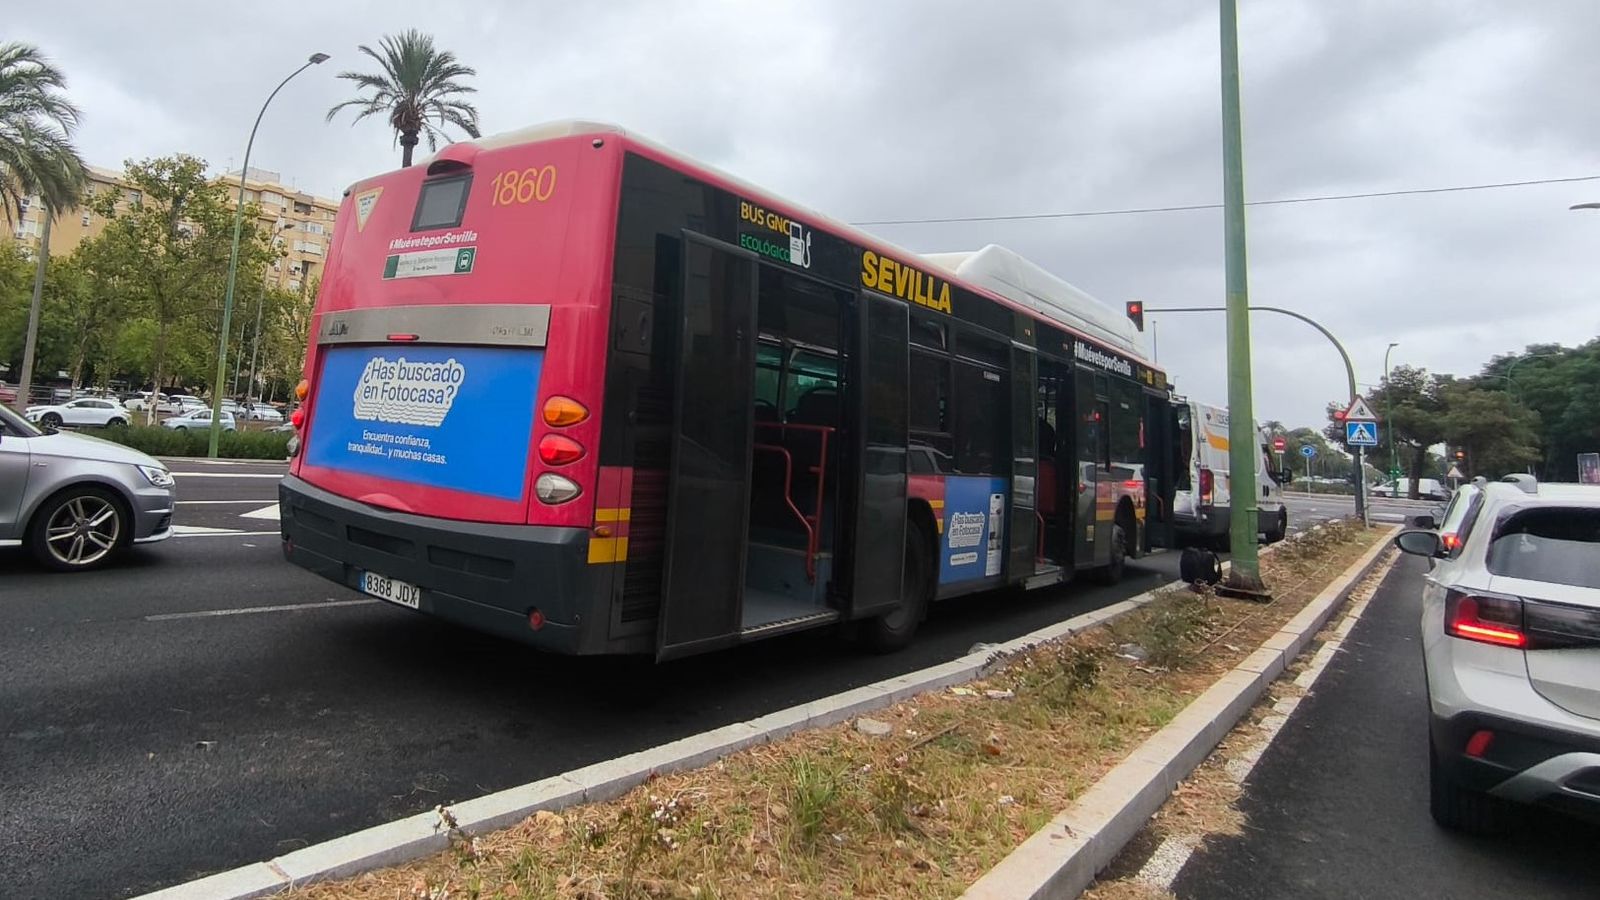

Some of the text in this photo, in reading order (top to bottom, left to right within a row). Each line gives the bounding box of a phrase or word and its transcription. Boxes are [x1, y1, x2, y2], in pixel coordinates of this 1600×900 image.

[492, 165, 557, 207] 1860
[741, 202, 790, 236] BUS GNC
[740, 234, 791, 262] ECOLÓGICO
[861, 250, 952, 314] SEVILLA
[363, 361, 462, 384] ¿Has buscado
[363, 382, 455, 405] en Fotocasa?
[363, 430, 431, 450] Encuentra confianza,
[388, 448, 393, 459] y
[393, 449, 422, 461] muchas
[422, 453, 448, 464] casas.
[367, 575, 417, 605] 8368 JDX
